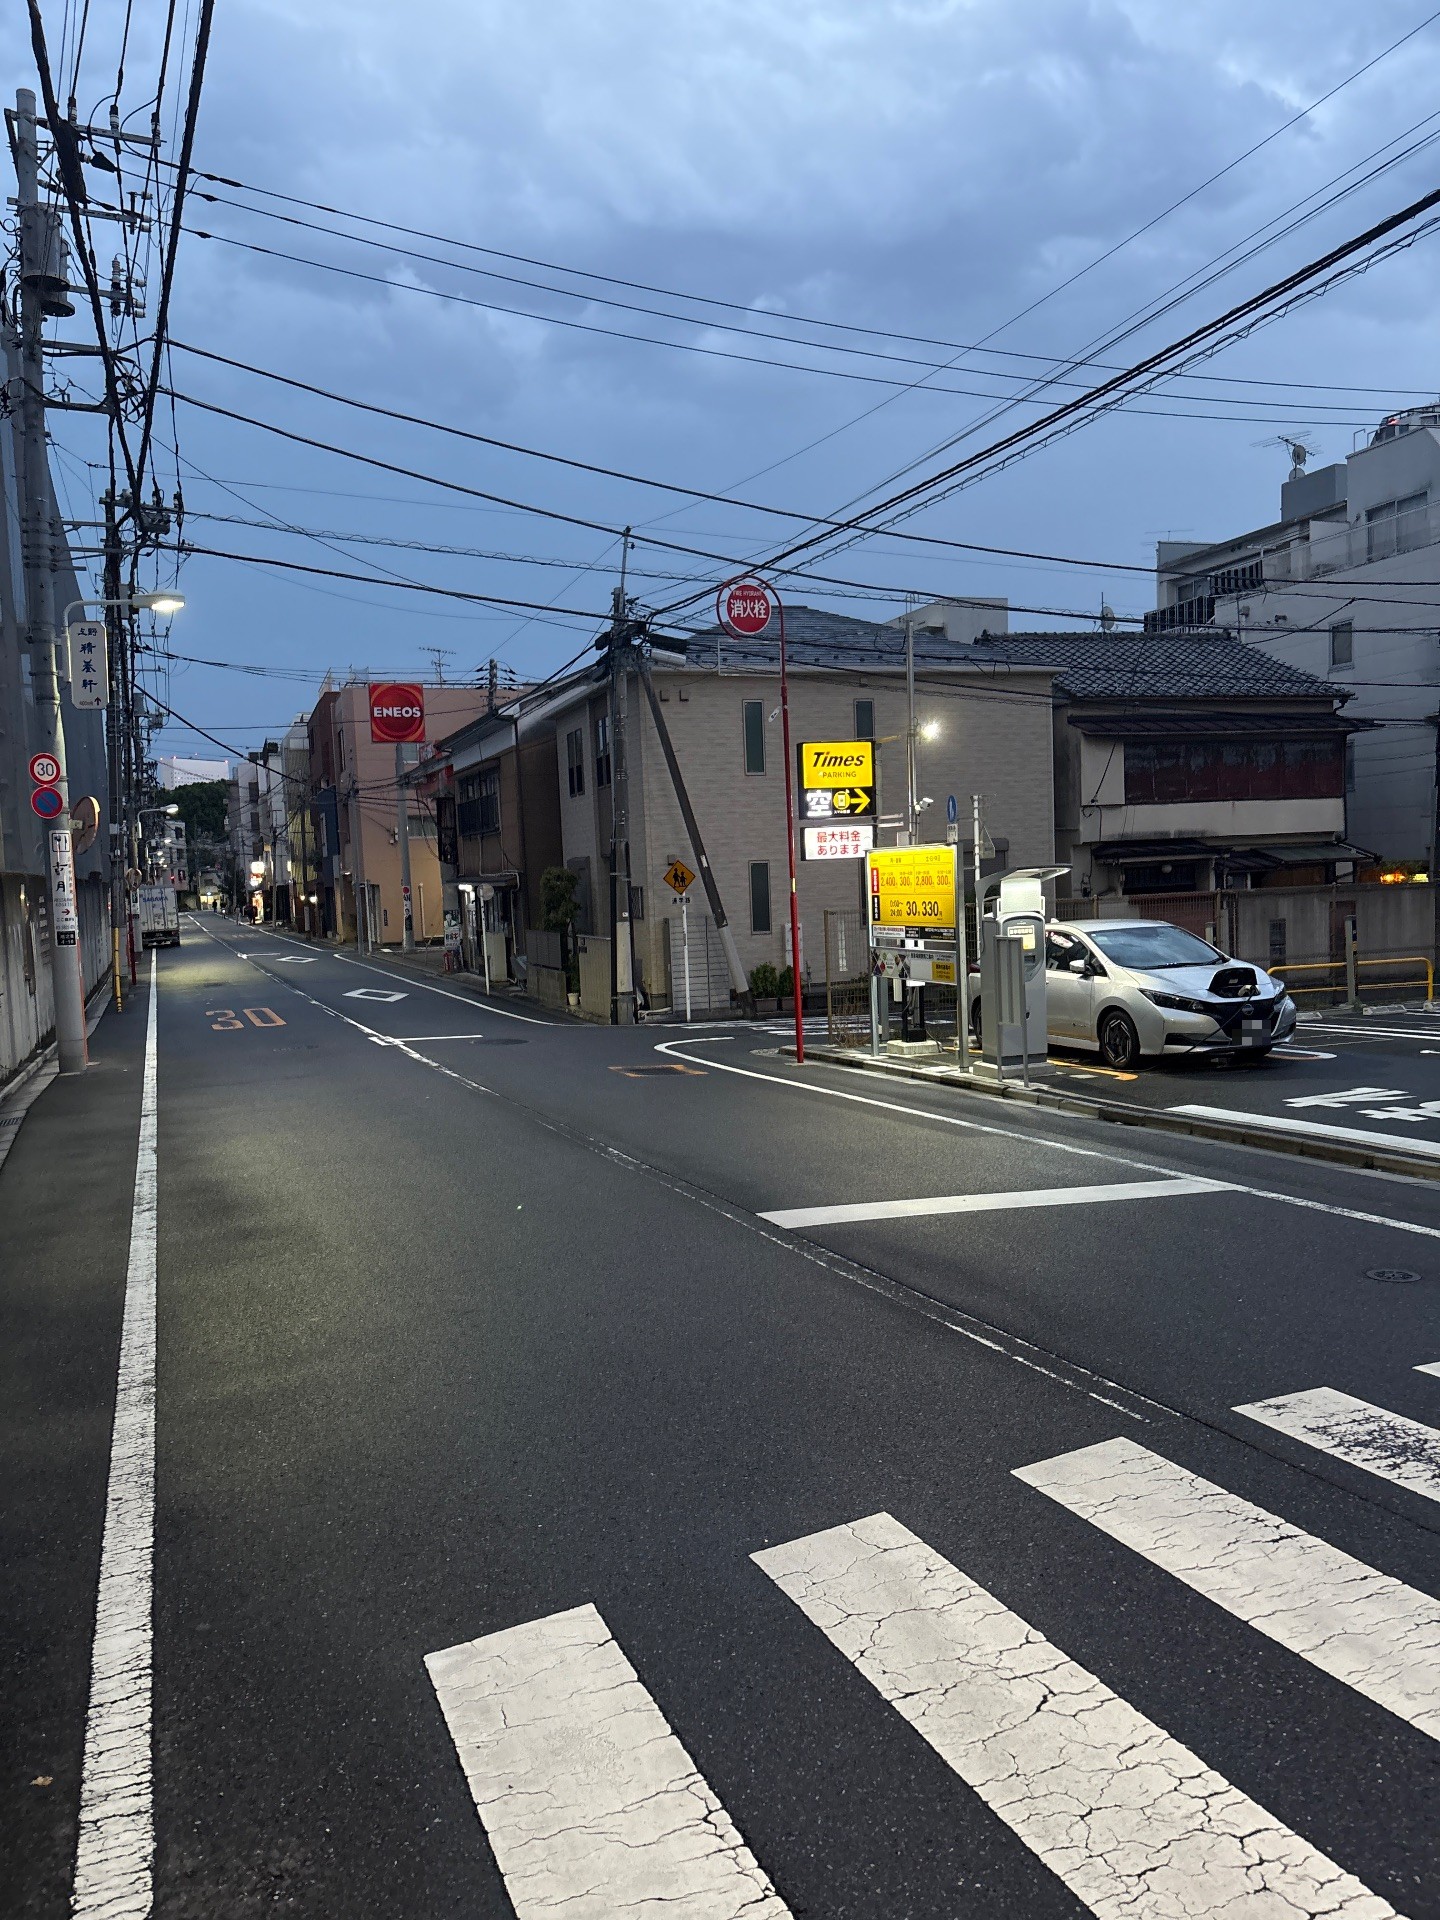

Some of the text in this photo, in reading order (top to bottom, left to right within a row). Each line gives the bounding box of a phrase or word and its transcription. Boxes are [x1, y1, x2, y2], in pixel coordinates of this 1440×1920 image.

[730, 599, 767, 618] 消火栓
[77, 627, 98, 637] 上野
[79, 641, 98, 693] 精養軒
[373, 706, 421, 718] ENEOS
[812, 751, 865, 768] Times
[37, 762, 54, 777] 30
[822, 770, 857, 779] PARKING
[806, 789, 833, 817] 空
[816, 830, 861, 843] 最大料金
[817, 843, 861, 856] あります
[205, 1007, 287, 1031] 30
